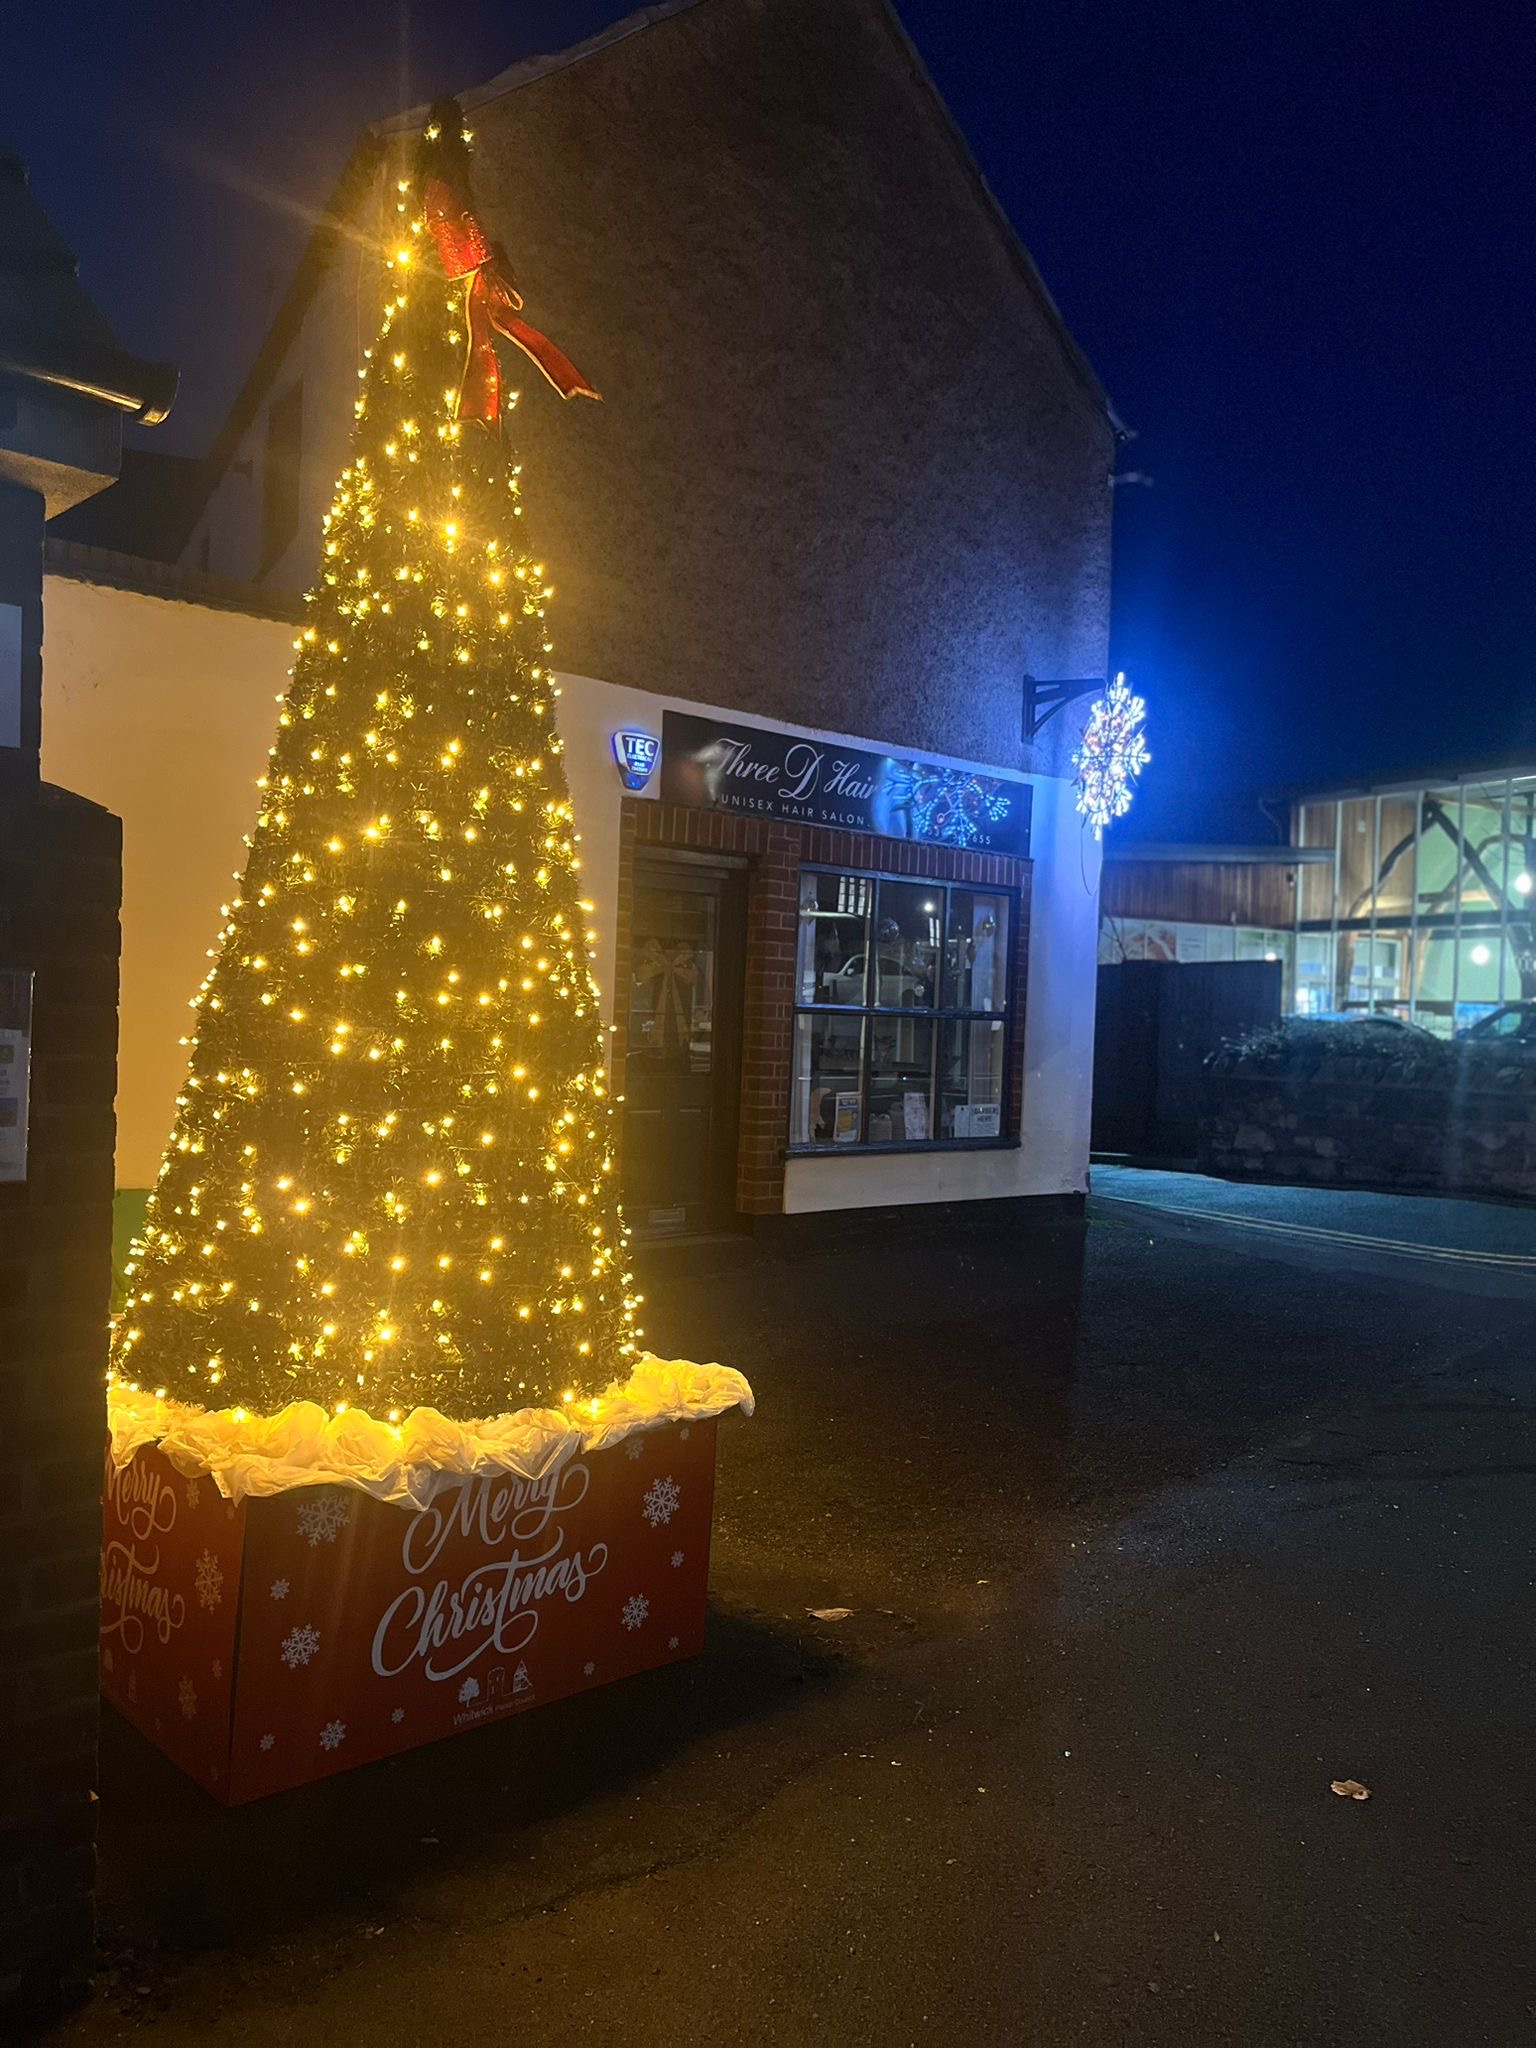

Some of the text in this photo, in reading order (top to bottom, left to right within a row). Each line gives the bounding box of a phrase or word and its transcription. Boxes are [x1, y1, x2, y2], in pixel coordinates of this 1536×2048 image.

[625, 737, 654, 757] TEC
[714, 738, 876, 801] Three D Hair
[721, 794, 774, 811] UNISEX
[781, 804, 814, 817] HAIR
[403, 1459, 590, 1575] Merry
[371, 1525, 609, 1682] Christmas
